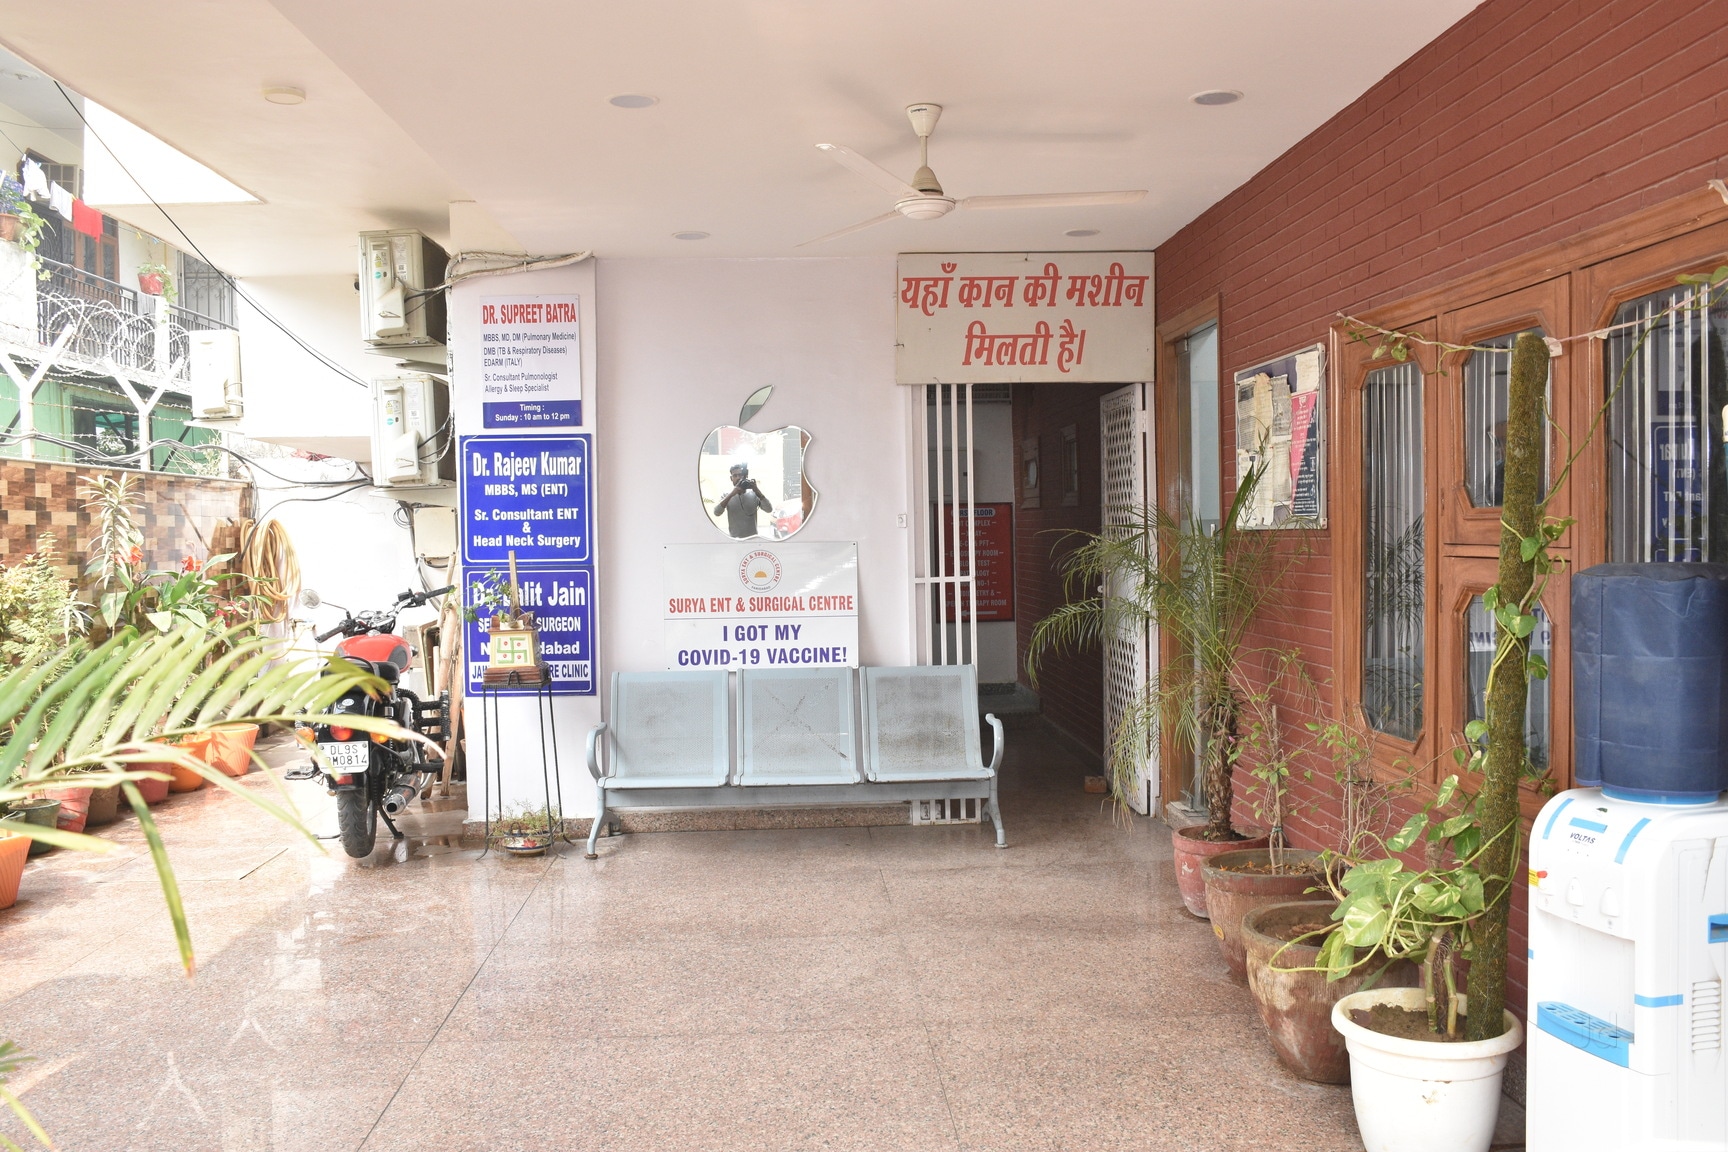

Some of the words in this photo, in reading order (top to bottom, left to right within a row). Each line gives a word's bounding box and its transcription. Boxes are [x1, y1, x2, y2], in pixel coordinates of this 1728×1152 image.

[901, 262, 958, 316] यहाँ
[959, 276, 1019, 308] कान
[1023, 262, 1062, 307] की
[1066, 262, 1149, 307] मशीन
[482, 304, 498, 324] DR.
[501, 304, 543, 324] SUPREET
[546, 303, 576, 322] BATRA
[483, 333, 500, 342] MBBS,
[502, 333, 512, 342] MD,
[512, 333, 520, 341] DM
[522, 332, 551, 342] (Pulmonary
[552, 332, 576, 342] Medicine)
[962, 320, 1054, 365] मिलती
[484, 348, 496, 356] DMB
[497, 348, 506, 356] (TB
[512, 347, 541, 356] Respiratory
[543, 346, 568, 355] Diseases)
[484, 359, 504, 367] EDARM
[505, 358, 522, 368] (ITALY)
[493, 372, 520, 382] Consultant
[521, 372, 558, 382] Pulmonologist
[485, 385, 502, 394] Allergy
[509, 384, 523, 394] Sleep
[524, 384, 550, 394] Specialist
[520, 404, 541, 412] Timing
[495, 414, 518, 422] Sunday
[560, 413, 570, 422] pm
[472, 452, 490, 477] Dr.
[494, 452, 537, 482] Rajeev
[540, 451, 582, 476] Kumar
[484, 484, 518, 497] MBBS,
[521, 484, 538, 495] MS
[541, 483, 568, 497] (ENT)
[474, 509, 489, 520] Sr.
[492, 508, 554, 521] Consultant
[557, 508, 579, 519] ENT
[522, 522, 531, 533] &
[473, 535, 503, 547] Head
[506, 534, 534, 546] Neck
[537, 534, 581, 548] Surgery
[548, 581, 586, 606] Jain
[669, 598, 706, 614] SURYA
[710, 597, 732, 613] ENT
[736, 597, 746, 612] &
[750, 596, 805, 612] SURGICAL
[809, 595, 854, 611] CENTRE
[723, 626, 728, 641] I
[734, 625, 768, 641] GOT
[775, 624, 802, 640] MY
[678, 648, 760, 666] COVID-19
[767, 647, 847, 664] VACCINE!
[562, 664, 588, 678] CLINIC
[330, 744, 358, 755] DL9S
[1570, 832, 1596, 844] VOLTAS
